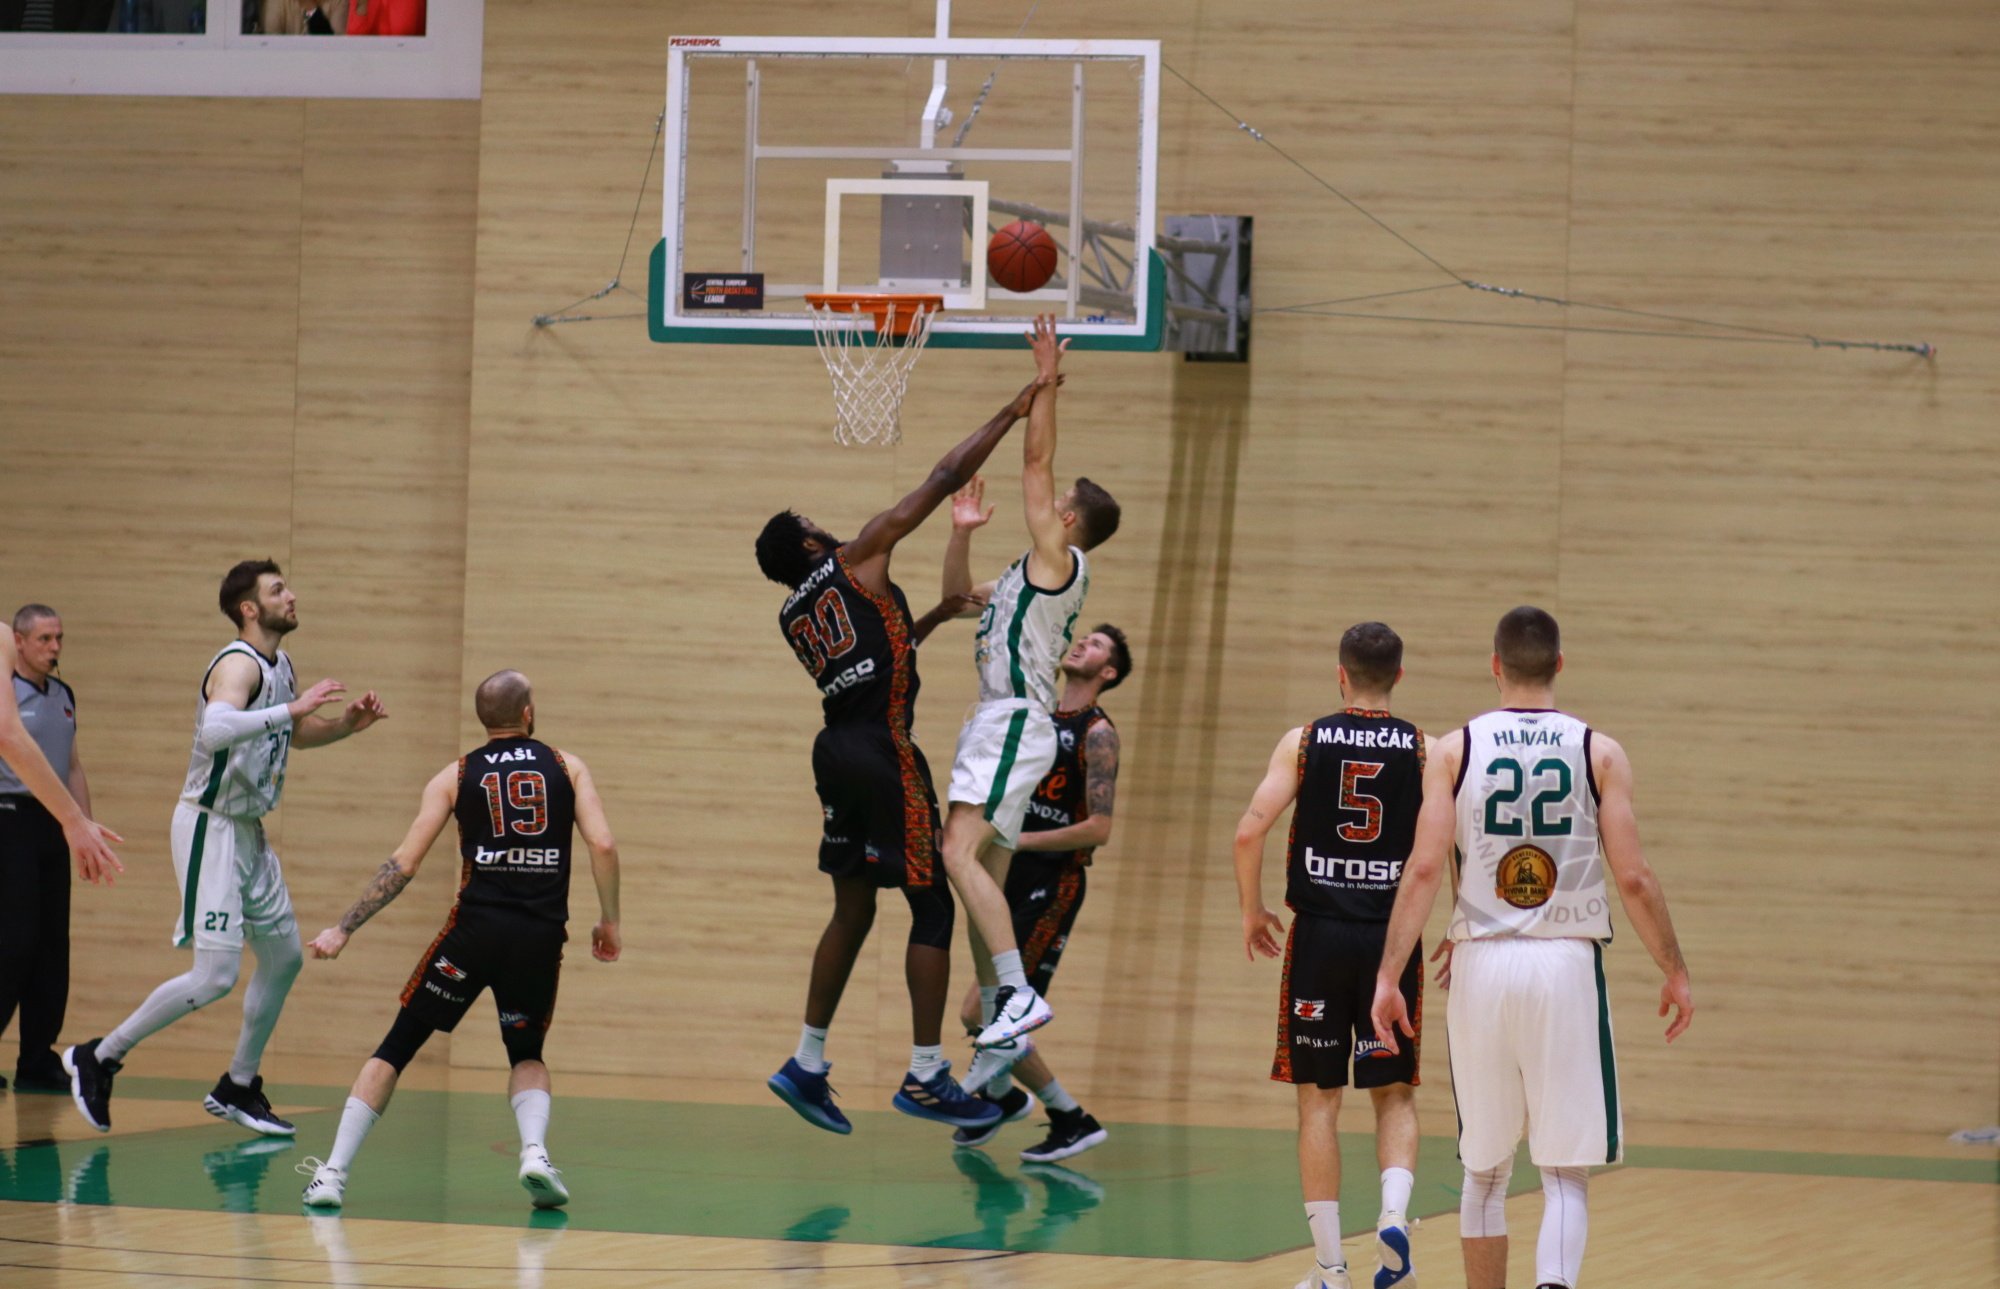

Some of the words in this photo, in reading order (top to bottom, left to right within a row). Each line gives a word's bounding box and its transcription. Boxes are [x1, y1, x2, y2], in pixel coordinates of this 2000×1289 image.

[704, 294, 726, 304] LEAGUE
[724, 286, 758, 295] BASKETBALL
[1317, 727, 1415, 750] MAJERČÁK
[484, 747, 537, 764] VAŠL
[479, 770, 548, 837] 19
[1336, 759, 1385, 843] 5
[1484, 757, 1573, 836] 22
[475, 845, 560, 866] brose
[205, 911, 229, 931] 27
